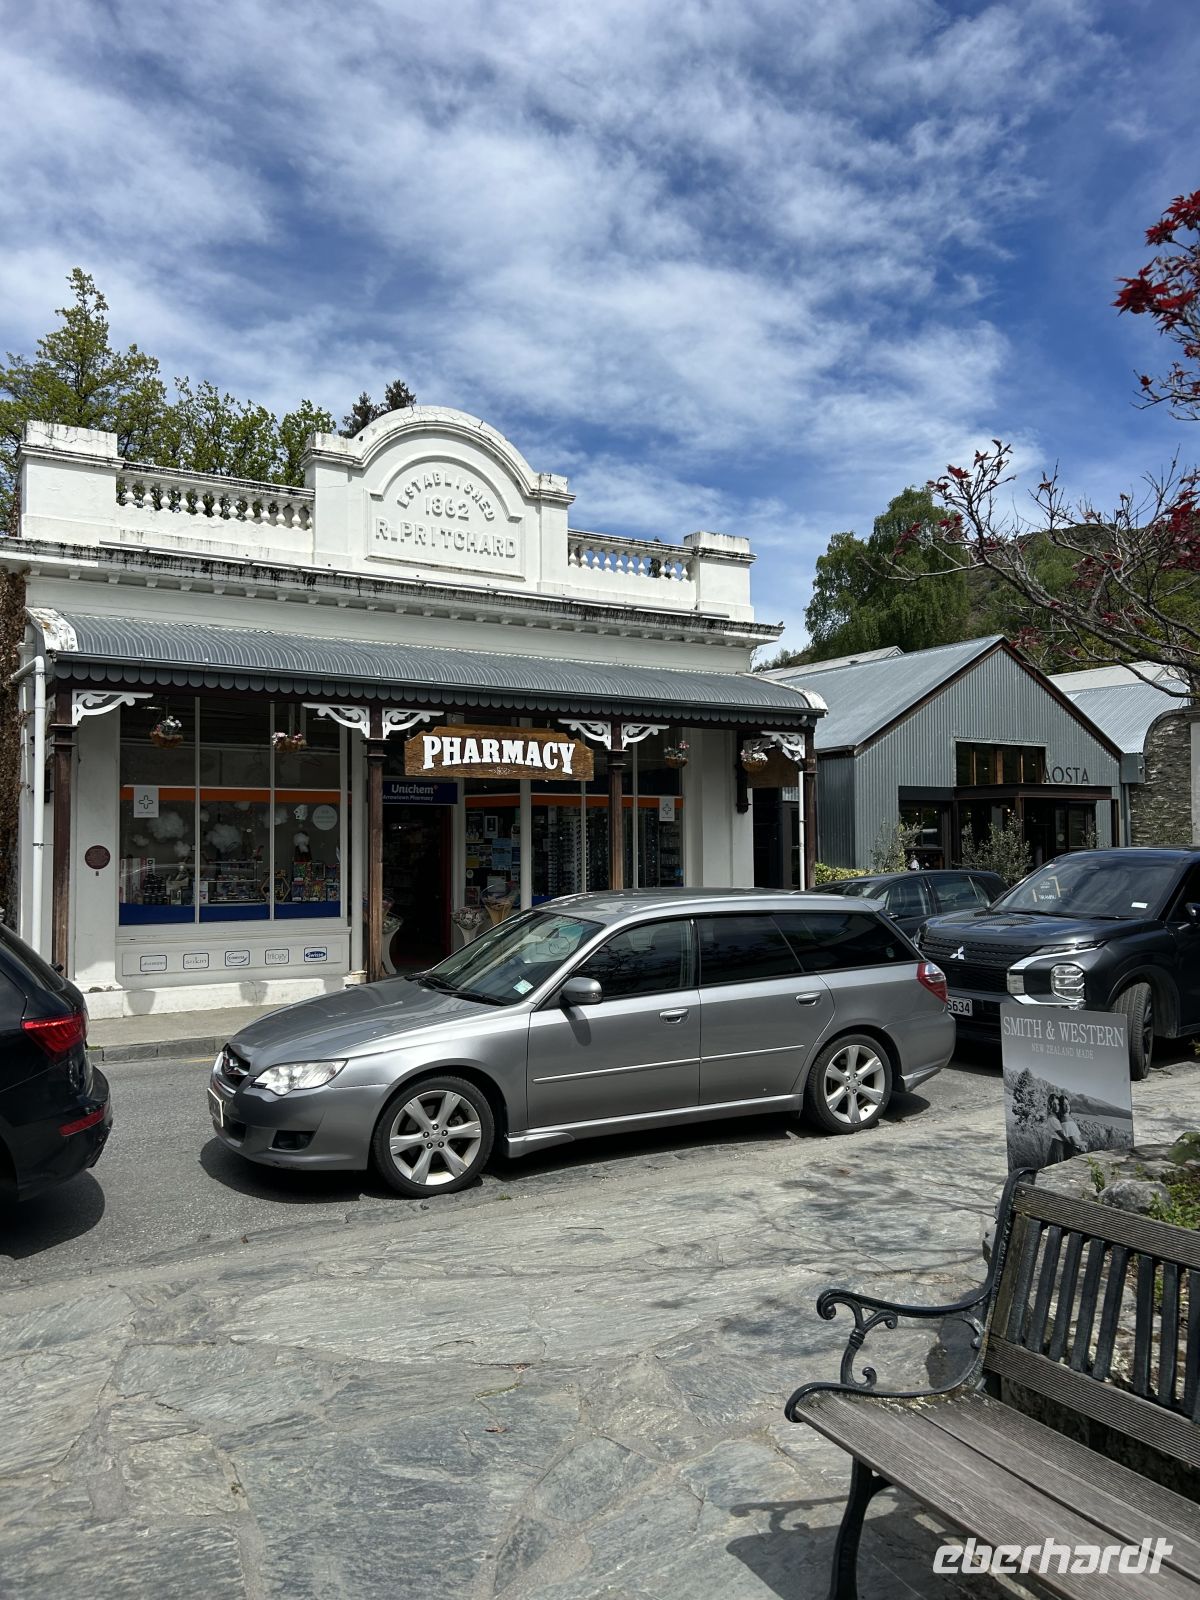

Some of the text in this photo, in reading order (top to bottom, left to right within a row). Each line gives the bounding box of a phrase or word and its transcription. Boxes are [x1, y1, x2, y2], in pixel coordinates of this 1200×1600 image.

[396, 470, 496, 522] ESTABLISHED
[424, 495, 470, 521] 1862
[422, 735, 576, 775] PHARMACY
[1042, 766, 1089, 784] AOSTA
[391, 783, 434, 794] Unichem
[1003, 1016, 1124, 1048] SMITH & WESTERN
[1031, 1042, 1094, 1060] NEW ZEALAND MADE
